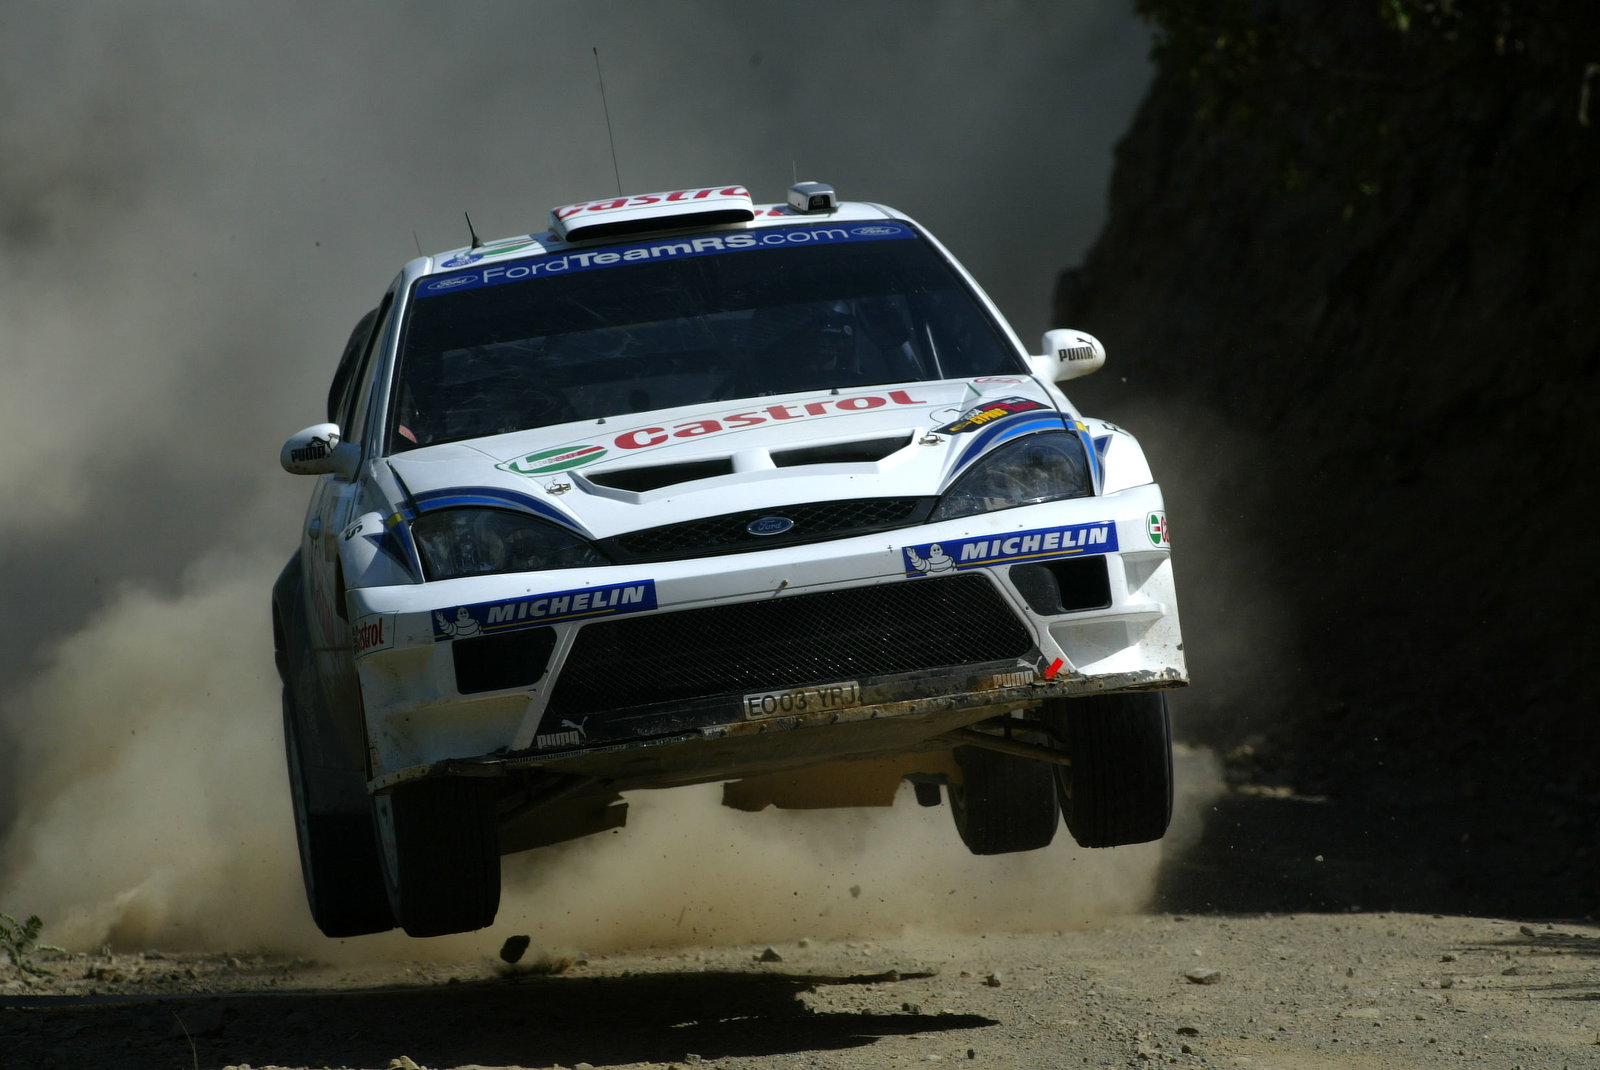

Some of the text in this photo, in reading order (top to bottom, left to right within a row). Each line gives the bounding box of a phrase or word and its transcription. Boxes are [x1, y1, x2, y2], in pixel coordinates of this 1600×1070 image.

[482, 228, 849, 283] FordTeamRS.com
[1058, 346, 1094, 362] PUMA
[614, 390, 927, 450] Castrol
[291, 445, 326, 463] PUMA
[960, 526, 1109, 560] MICHELIN
[487, 585, 645, 624] MICHELIN
[993, 670, 1034, 689] PUMA
[817, 684, 857, 708] YRJ
[537, 730, 580, 749] PUMA
